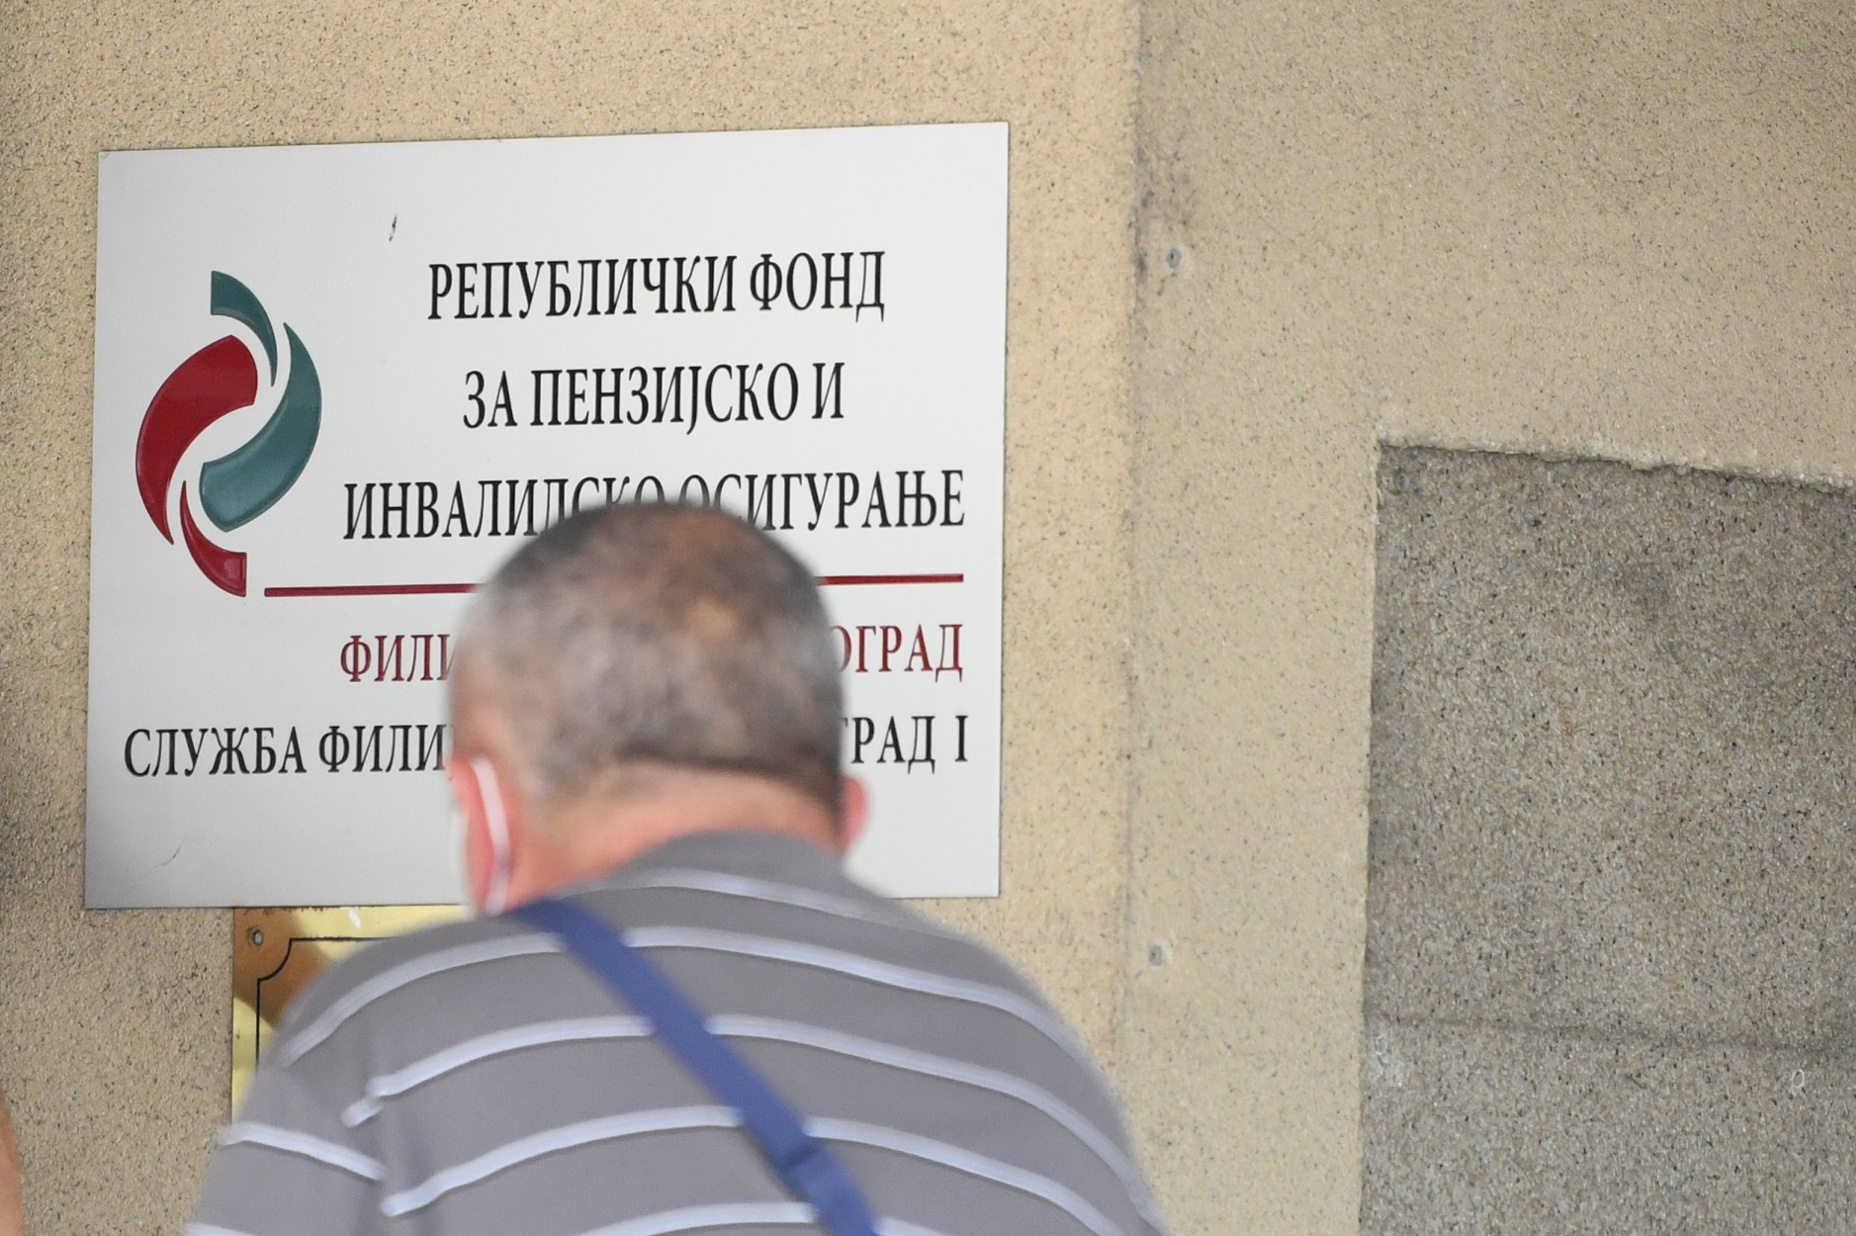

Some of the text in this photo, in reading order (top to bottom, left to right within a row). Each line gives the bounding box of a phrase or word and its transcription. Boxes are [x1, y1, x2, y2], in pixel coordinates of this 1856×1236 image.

[428, 251, 885, 323] РЕПУБЛИЧКИ ФОНД
[463, 361, 846, 435] ЗА ПЕНЗИЈСКО И
[124, 726, 308, 778] СЛУЖБА
[319, 724, 448, 774] ФИЛИ
